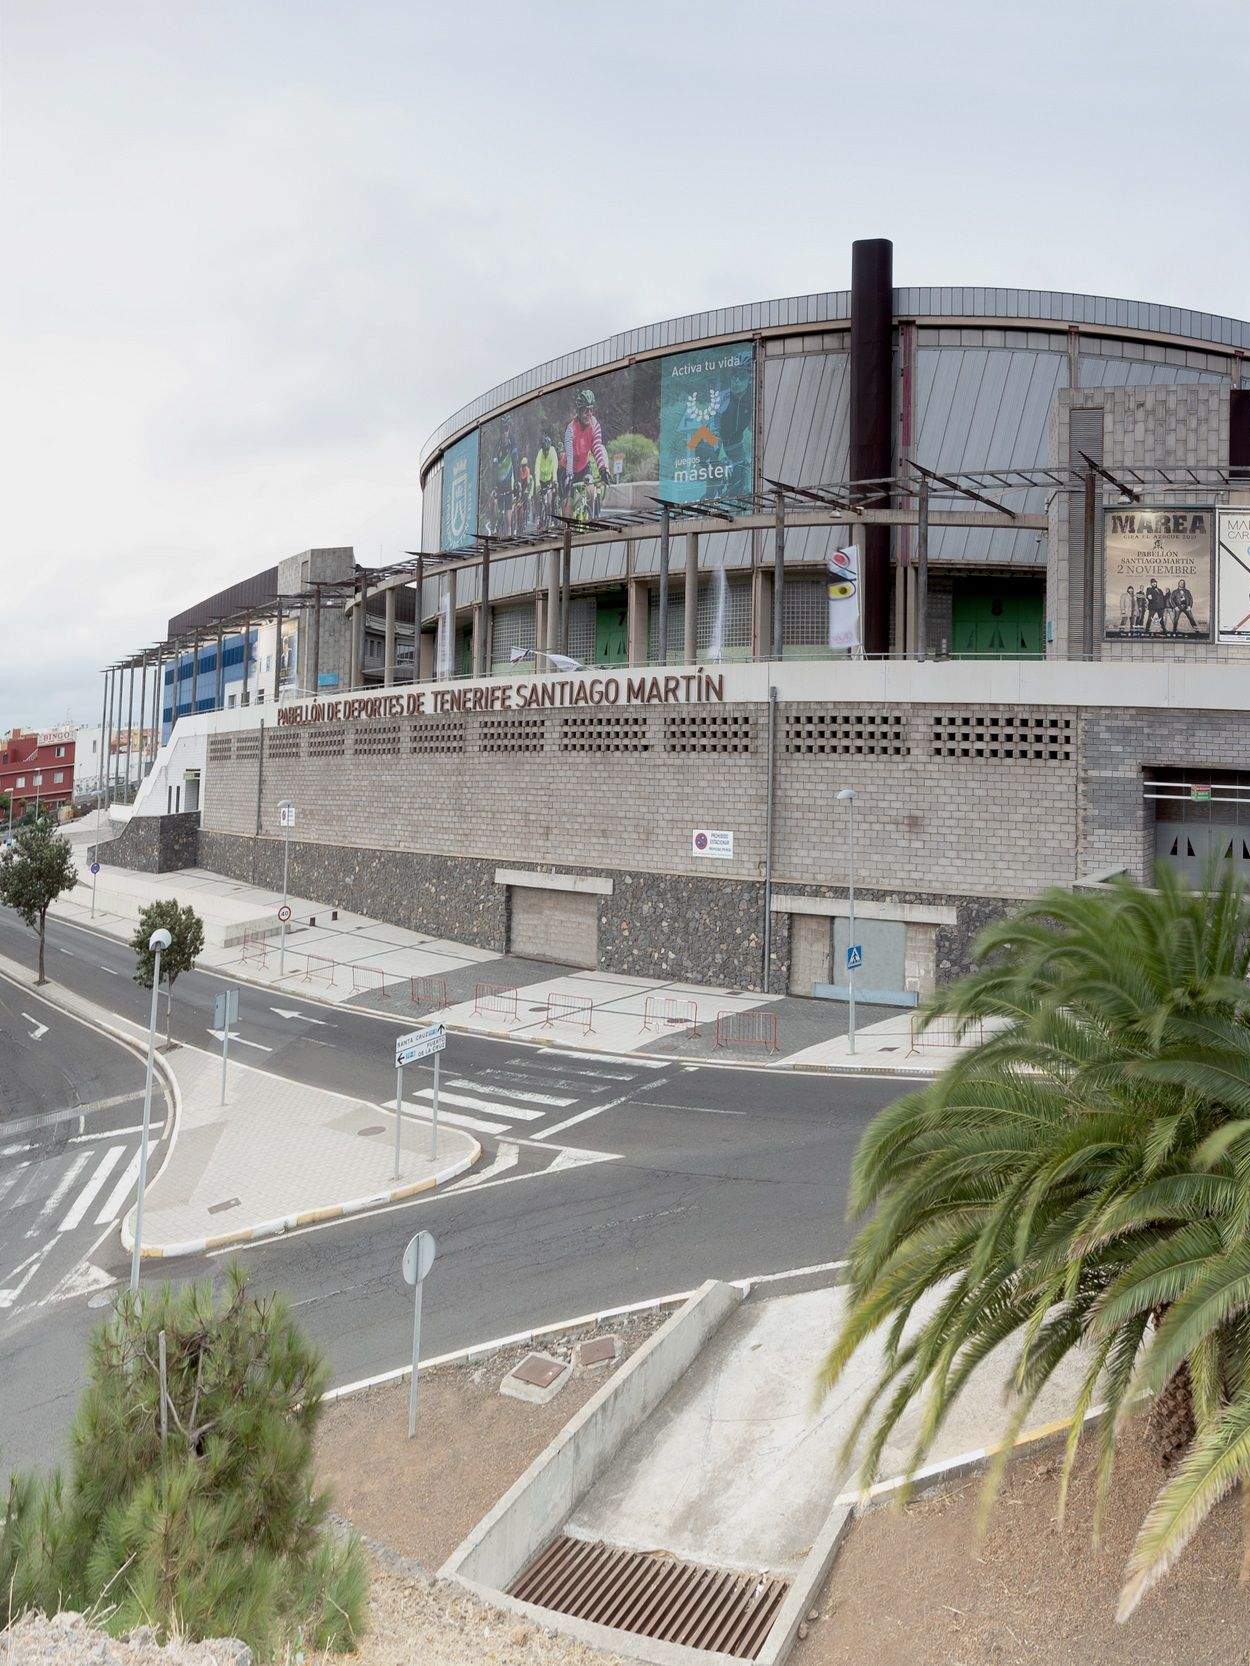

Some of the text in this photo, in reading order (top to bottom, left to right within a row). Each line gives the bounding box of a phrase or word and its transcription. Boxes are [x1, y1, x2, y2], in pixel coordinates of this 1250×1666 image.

[671, 356, 741, 378] Activa tu vida
[674, 455, 701, 469] juegos
[673, 464, 733, 484] máster
[1111, 514, 1207, 534] MAREA
[1117, 564, 1197, 575] 2 NOVIEMBRE
[277, 666, 724, 726] PABELLÓN DE DEPORTES DE TENERIFE SANTIAGO MARTÍN
[43, 731, 70, 742] BINGO
[397, 1037, 413, 1047] SANTA
